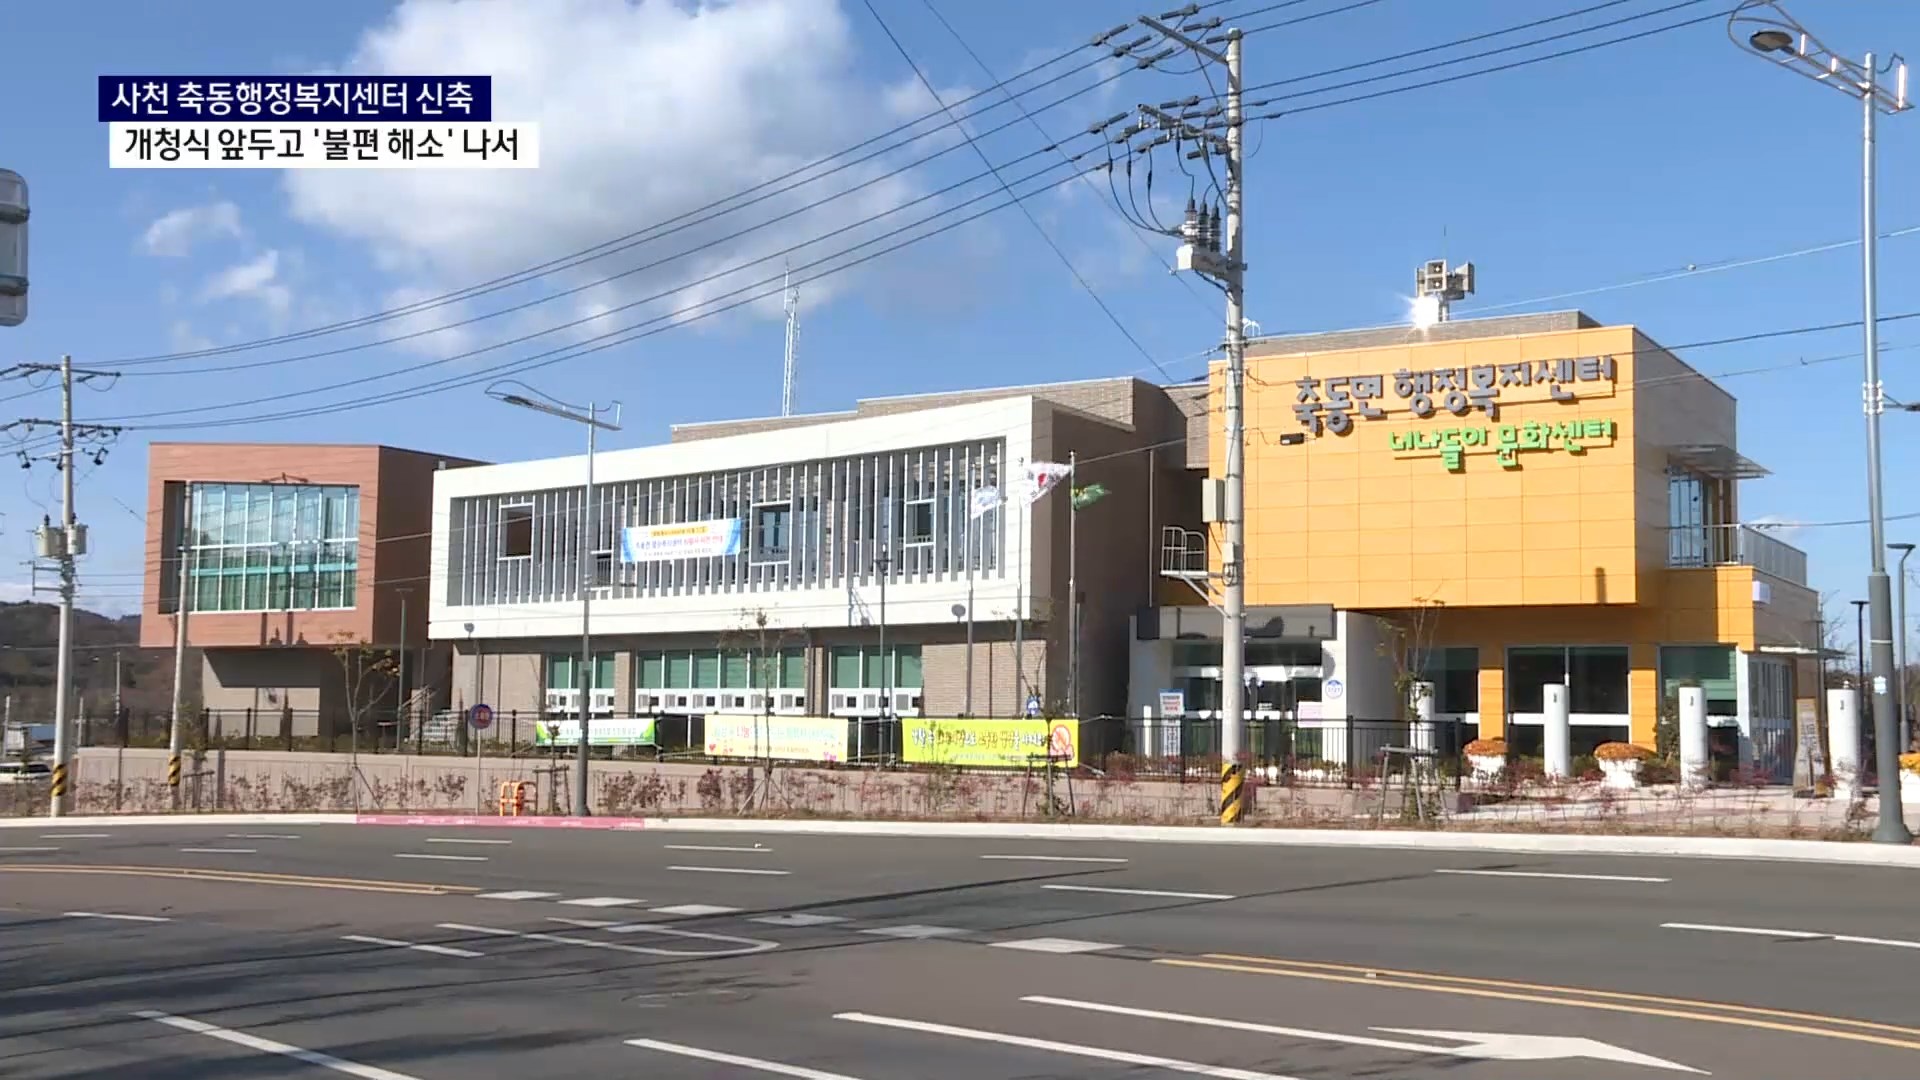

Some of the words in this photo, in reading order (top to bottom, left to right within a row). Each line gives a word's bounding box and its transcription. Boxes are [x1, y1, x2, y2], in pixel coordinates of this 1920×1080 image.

[1292, 374, 1383, 433] 축동면
[1393, 355, 1614, 418] 행정복지센터
[1389, 427, 1487, 468] 너나들이
[1496, 418, 1612, 466] 문화센터
